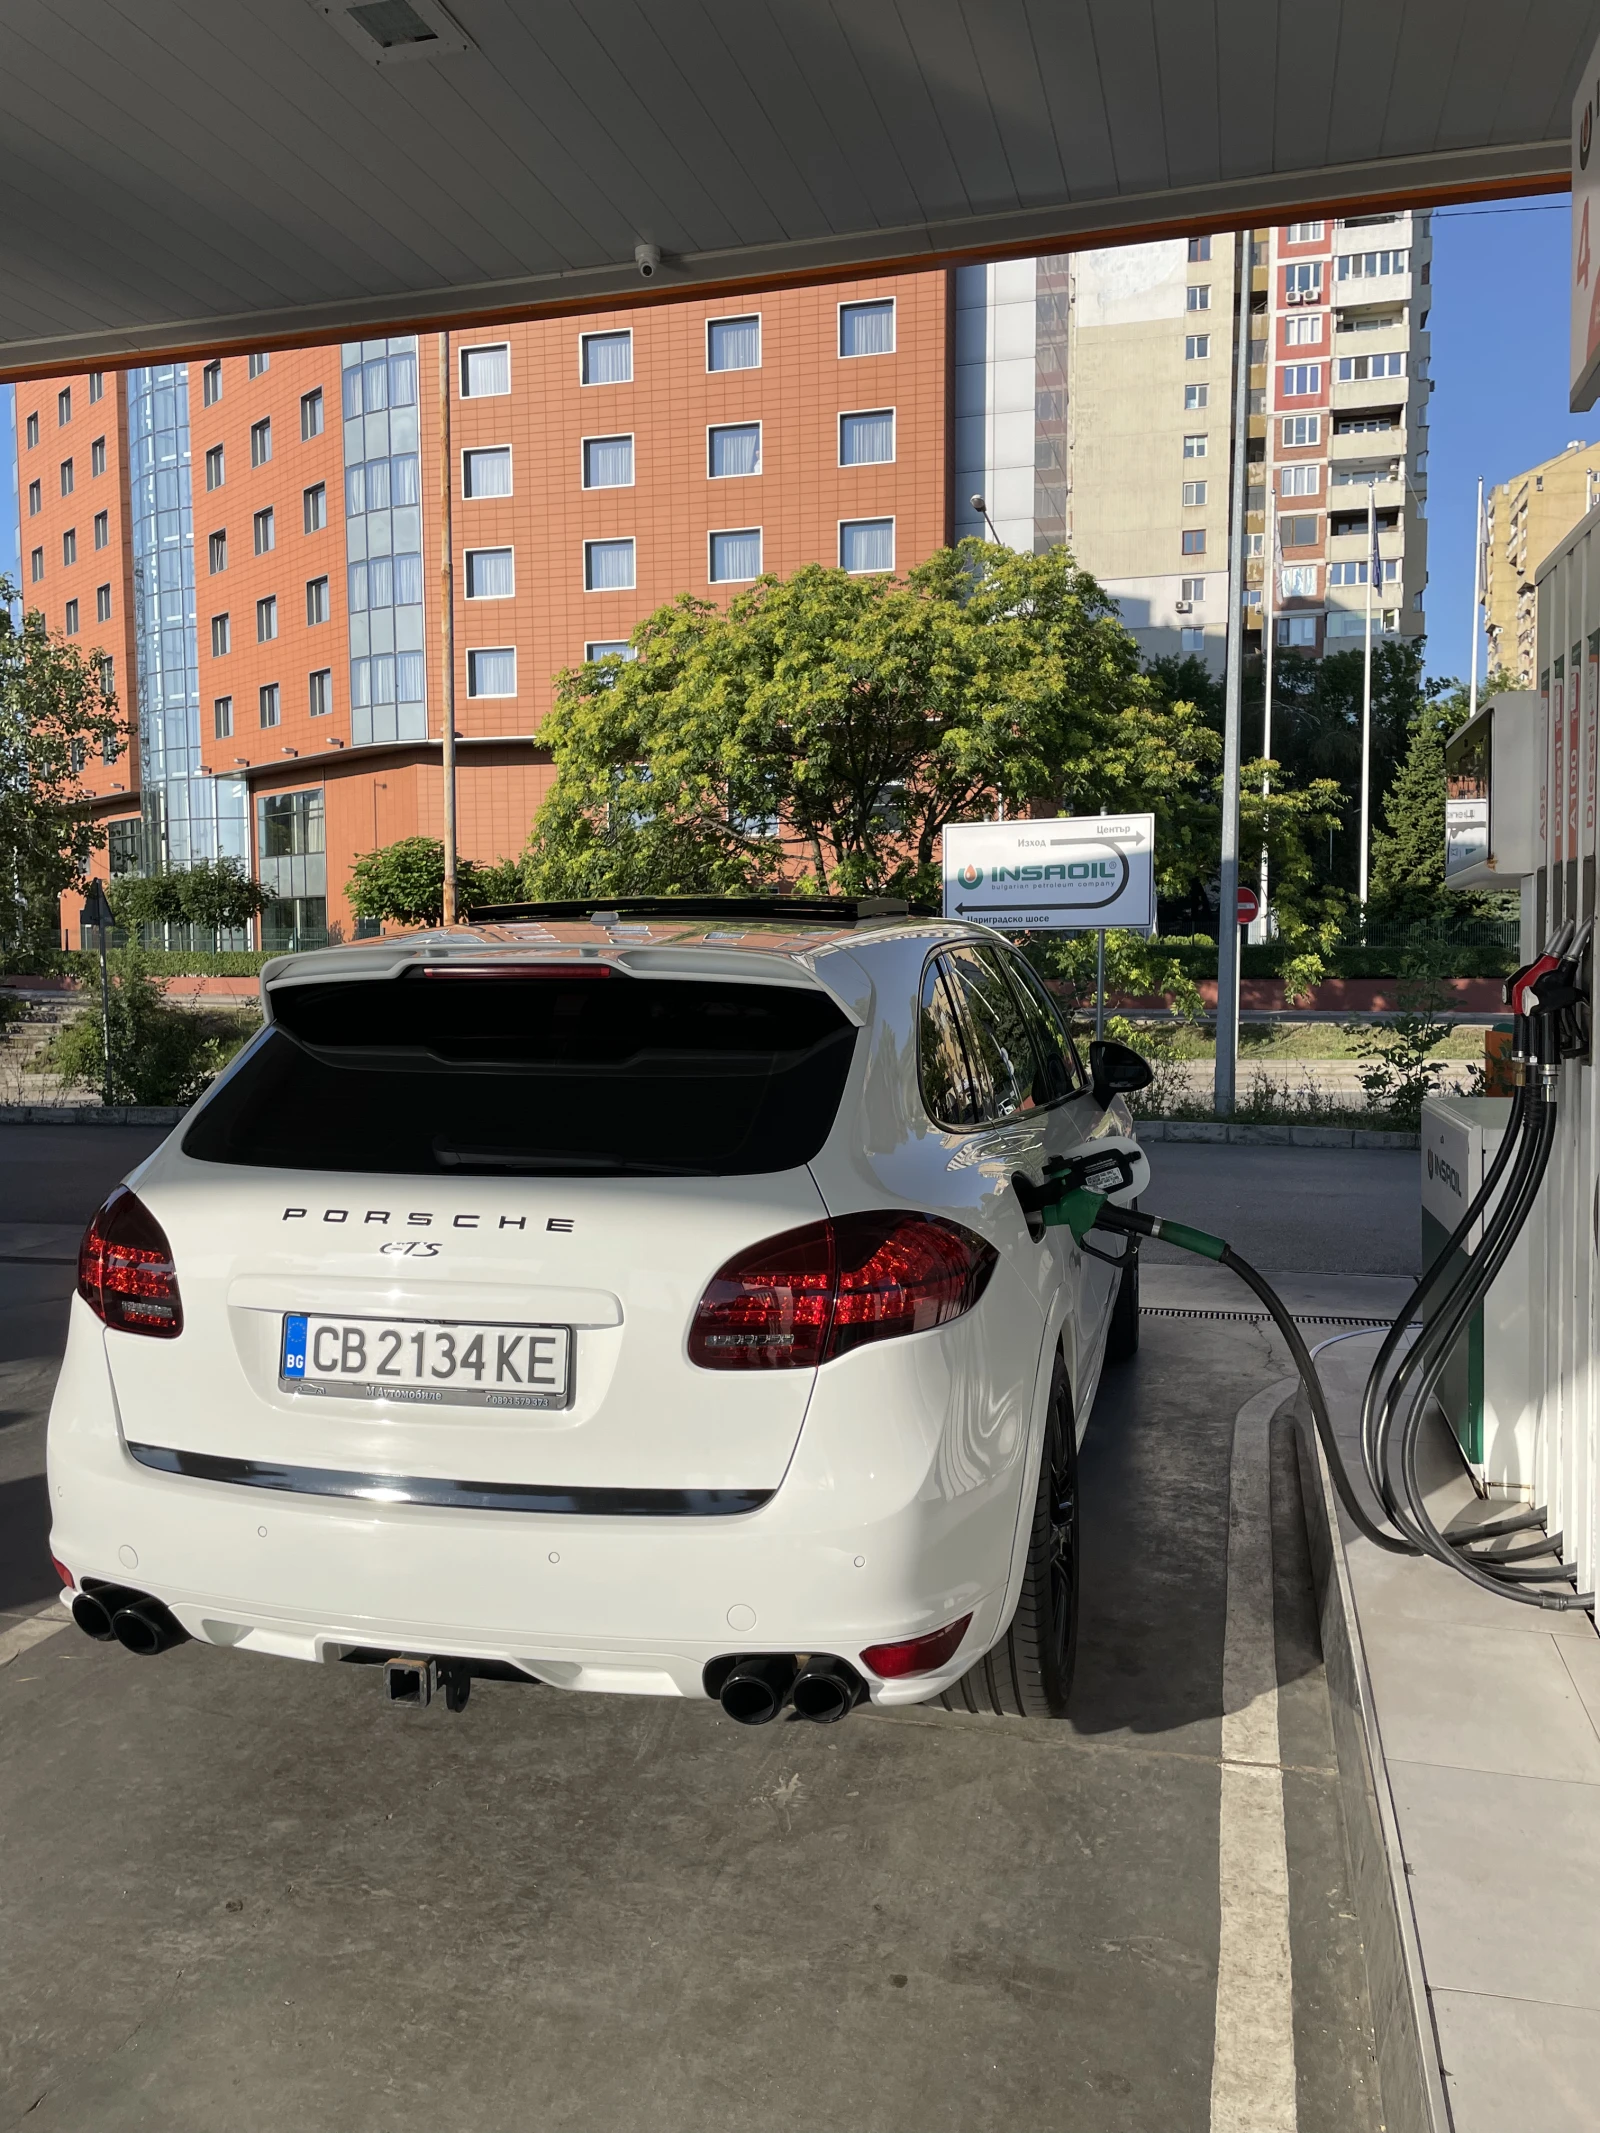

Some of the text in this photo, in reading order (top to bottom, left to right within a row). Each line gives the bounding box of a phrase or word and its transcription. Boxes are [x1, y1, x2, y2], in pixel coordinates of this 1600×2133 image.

[1576, 196, 1591, 291] 4
[1569, 748, 1578, 831] A100
[1096, 825, 1131, 835] Център
[1018, 838, 1047, 848] Изход
[991, 881, 1116, 891] bulgarian petroleum company
[1025, 914, 1050, 923] шосе
[1434, 1154, 1462, 1198] INSAOIL
[282, 1207, 575, 1233] PORSCHE
[379, 1241, 443, 1258] GTS
[286, 1353, 305, 1369] BG
[313, 1326, 557, 1385] CB 2134 KE
